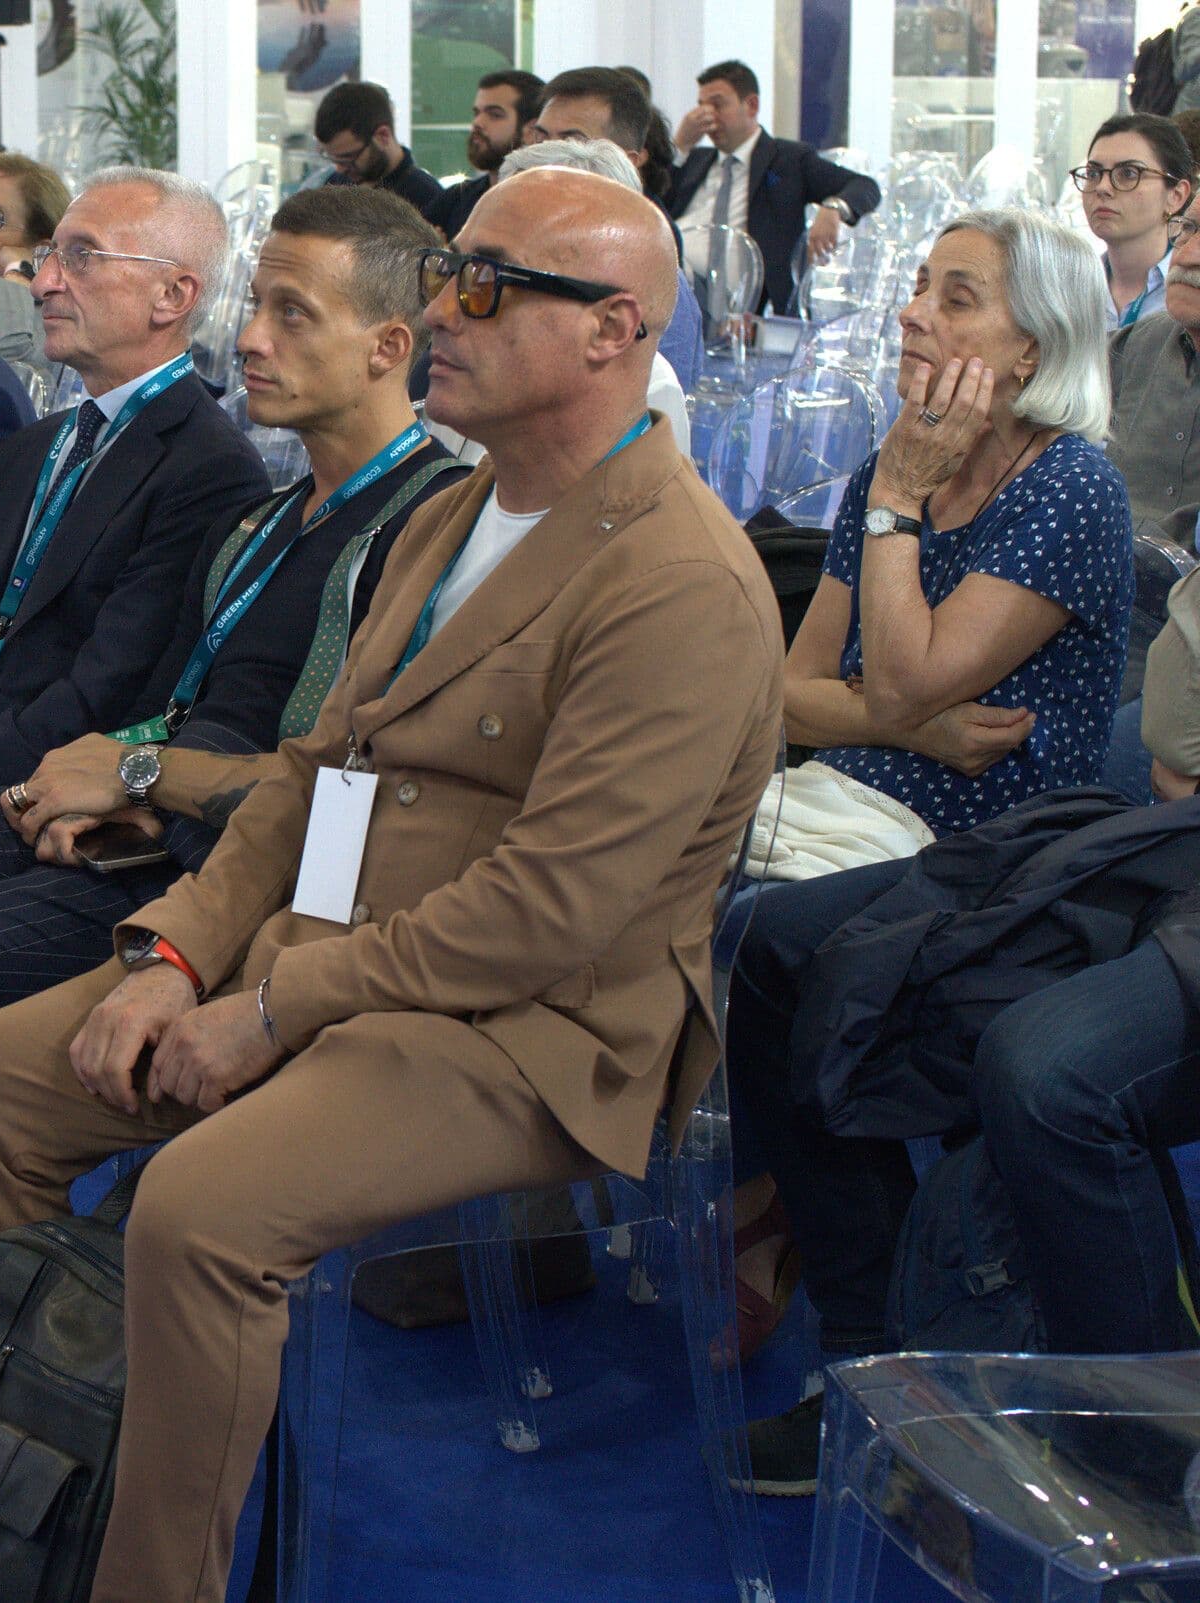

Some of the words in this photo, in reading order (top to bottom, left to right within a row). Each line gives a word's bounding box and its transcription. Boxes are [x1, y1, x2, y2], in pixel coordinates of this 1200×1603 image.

[49, 477, 73, 517] ECOMONDO
[343, 465, 382, 500] ECOMONDO
[216, 599, 243, 629] GREEN
[242, 581, 259, 601] MED
